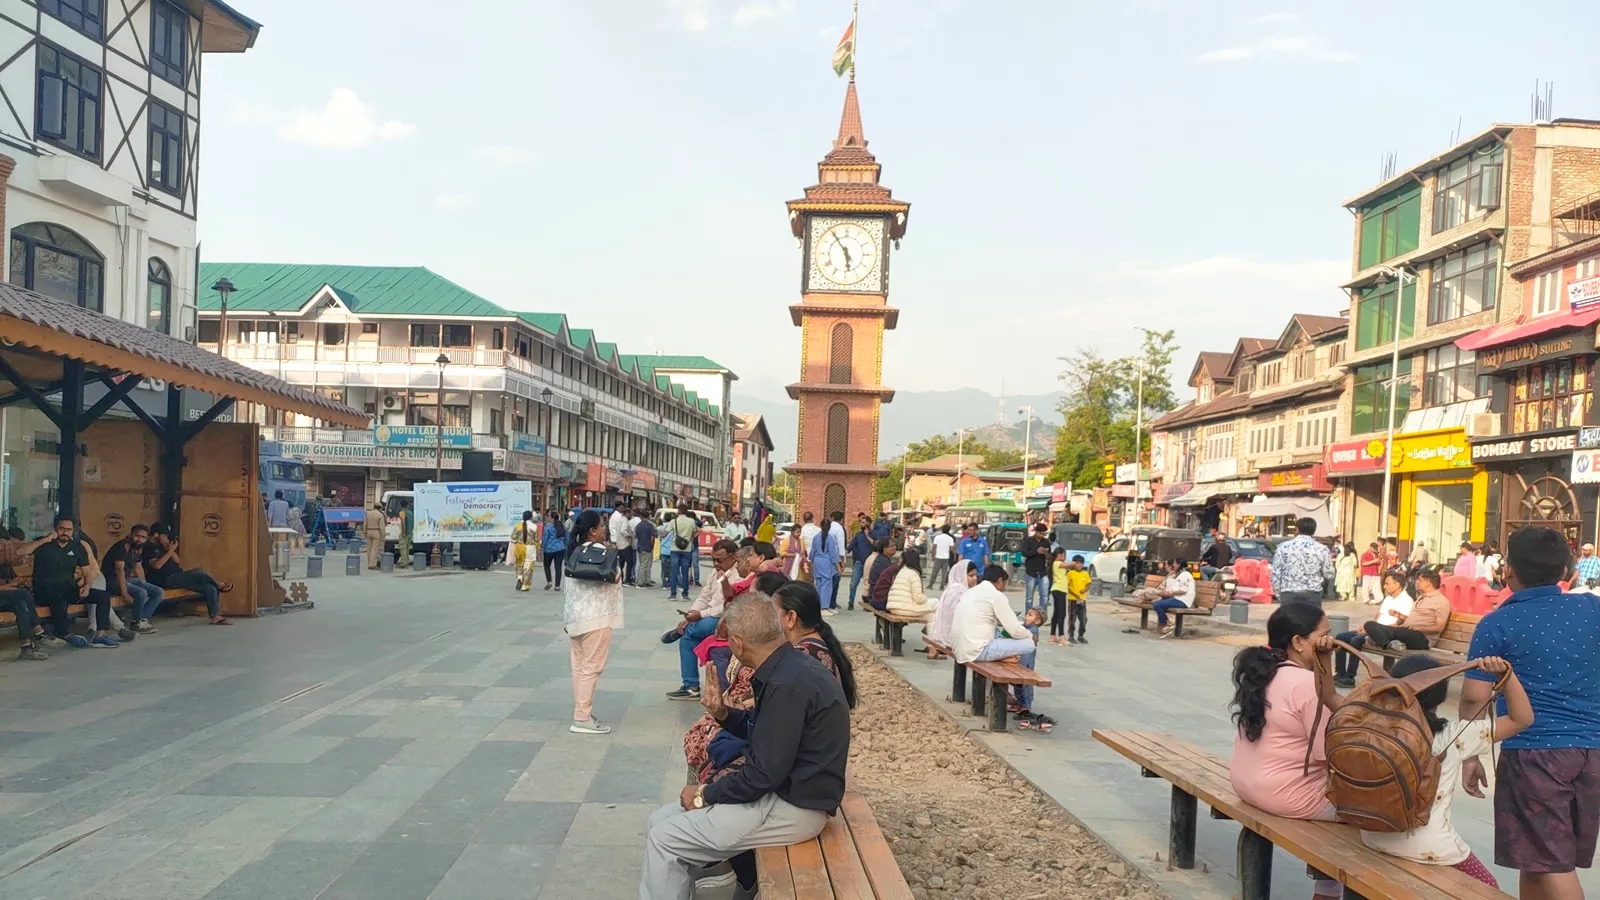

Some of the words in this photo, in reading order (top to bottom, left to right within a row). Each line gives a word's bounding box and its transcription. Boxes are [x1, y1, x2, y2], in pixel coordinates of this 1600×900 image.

[1540, 340, 1572, 355] SUITING
[190, 409, 206, 419] BES
[392, 427, 417, 435] HOTEL
[419, 427, 439, 435] LALA
[443, 427, 469, 436] RUKH
[280, 444, 309, 454] SHMIR
[313, 445, 378, 457] GOVERNMENT
[382, 447, 405, 457] ARTS
[408, 448, 463, 459] EMPOIUM
[1473, 441, 1525, 458] BOMBAY
[1531, 435, 1576, 452] STORE
